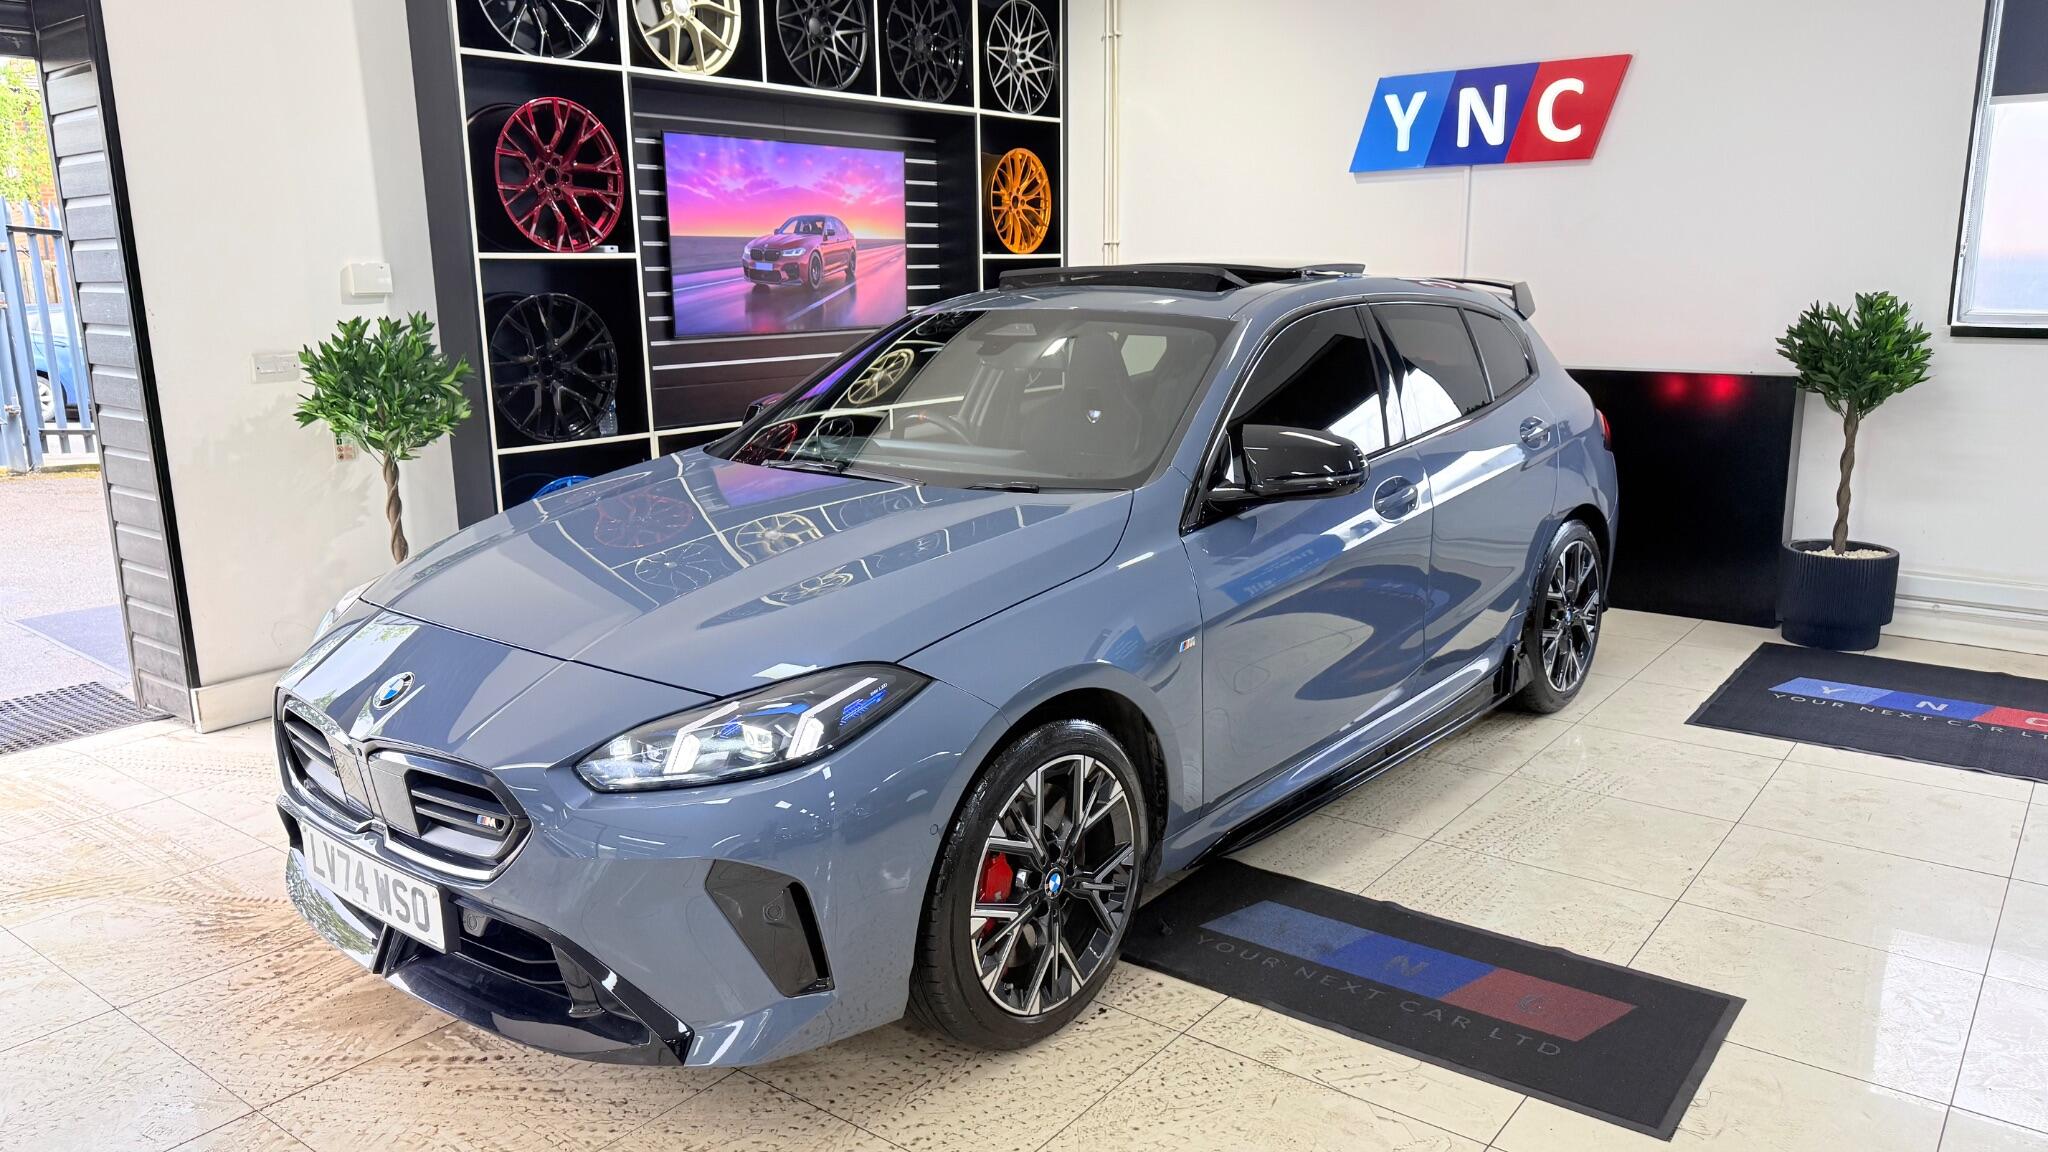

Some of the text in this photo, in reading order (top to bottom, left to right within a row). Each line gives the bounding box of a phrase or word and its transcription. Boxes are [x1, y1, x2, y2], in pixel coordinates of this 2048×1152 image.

[1384, 77, 1584, 152] YNC
[1773, 693, 1846, 708] YOUR
[1859, 706, 1933, 721] NEXT
[1947, 719, 2007, 733] CAR
[310, 833, 431, 933] LV74 WSO
[1198, 935, 1561, 1056] YOUR NEXT CAR LTD
